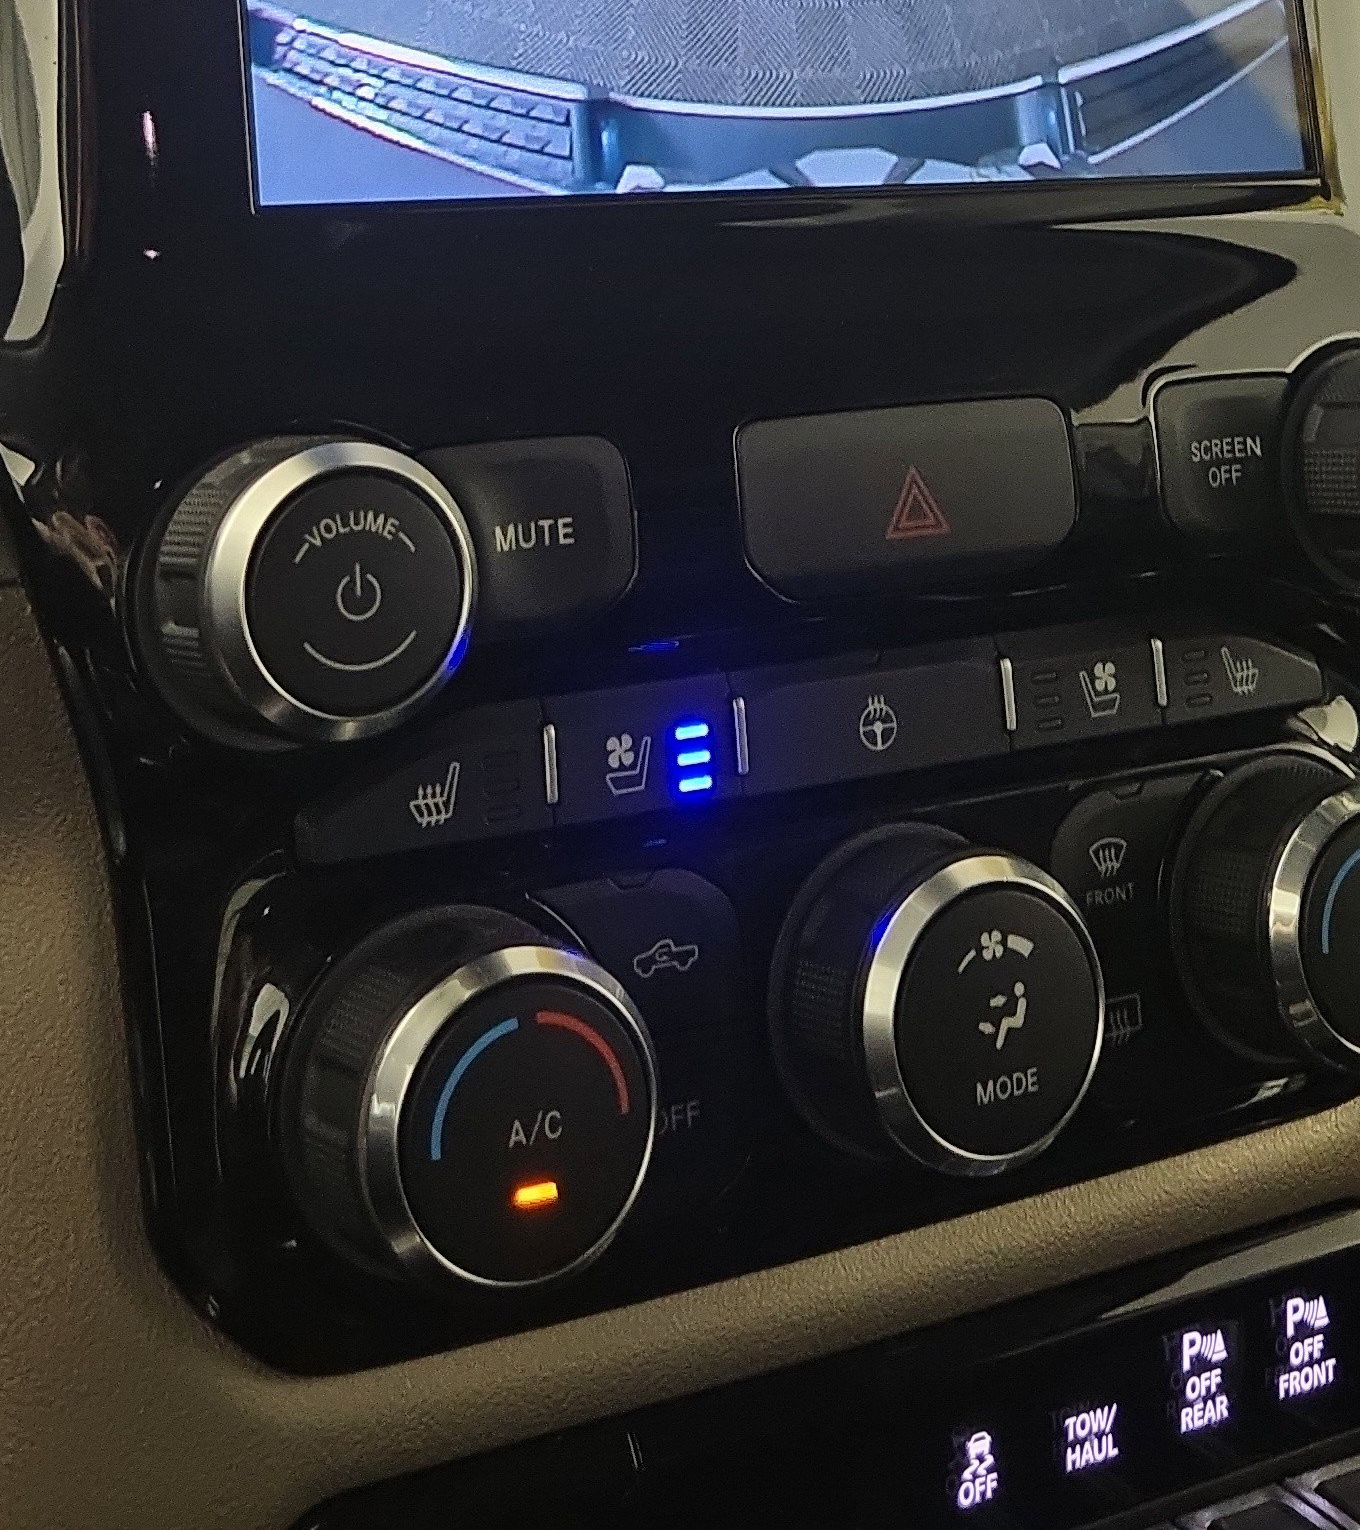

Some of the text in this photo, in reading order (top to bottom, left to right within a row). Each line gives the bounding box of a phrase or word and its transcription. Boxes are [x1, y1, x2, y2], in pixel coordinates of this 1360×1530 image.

[1189, 434, 1263, 463] SCREEN
[1207, 465, 1242, 488] OFF
[304, 509, 401, 549] VOLUME
[493, 516, 575, 553] MUTE
[1085, 881, 1135, 908] FRONT
[975, 1067, 1040, 1106] MODE
[508, 1109, 564, 1149] A/C
[1289, 1333, 1324, 1368] OFF
[1185, 1368, 1223, 1403] OFF
[1278, 1358, 1337, 1401] FRONT
[1063, 1402, 1118, 1443] TOW/
[1180, 1396, 1230, 1435] REAR
[1065, 1432, 1120, 1473] HAUL
[957, 1472, 999, 1510] OFF
